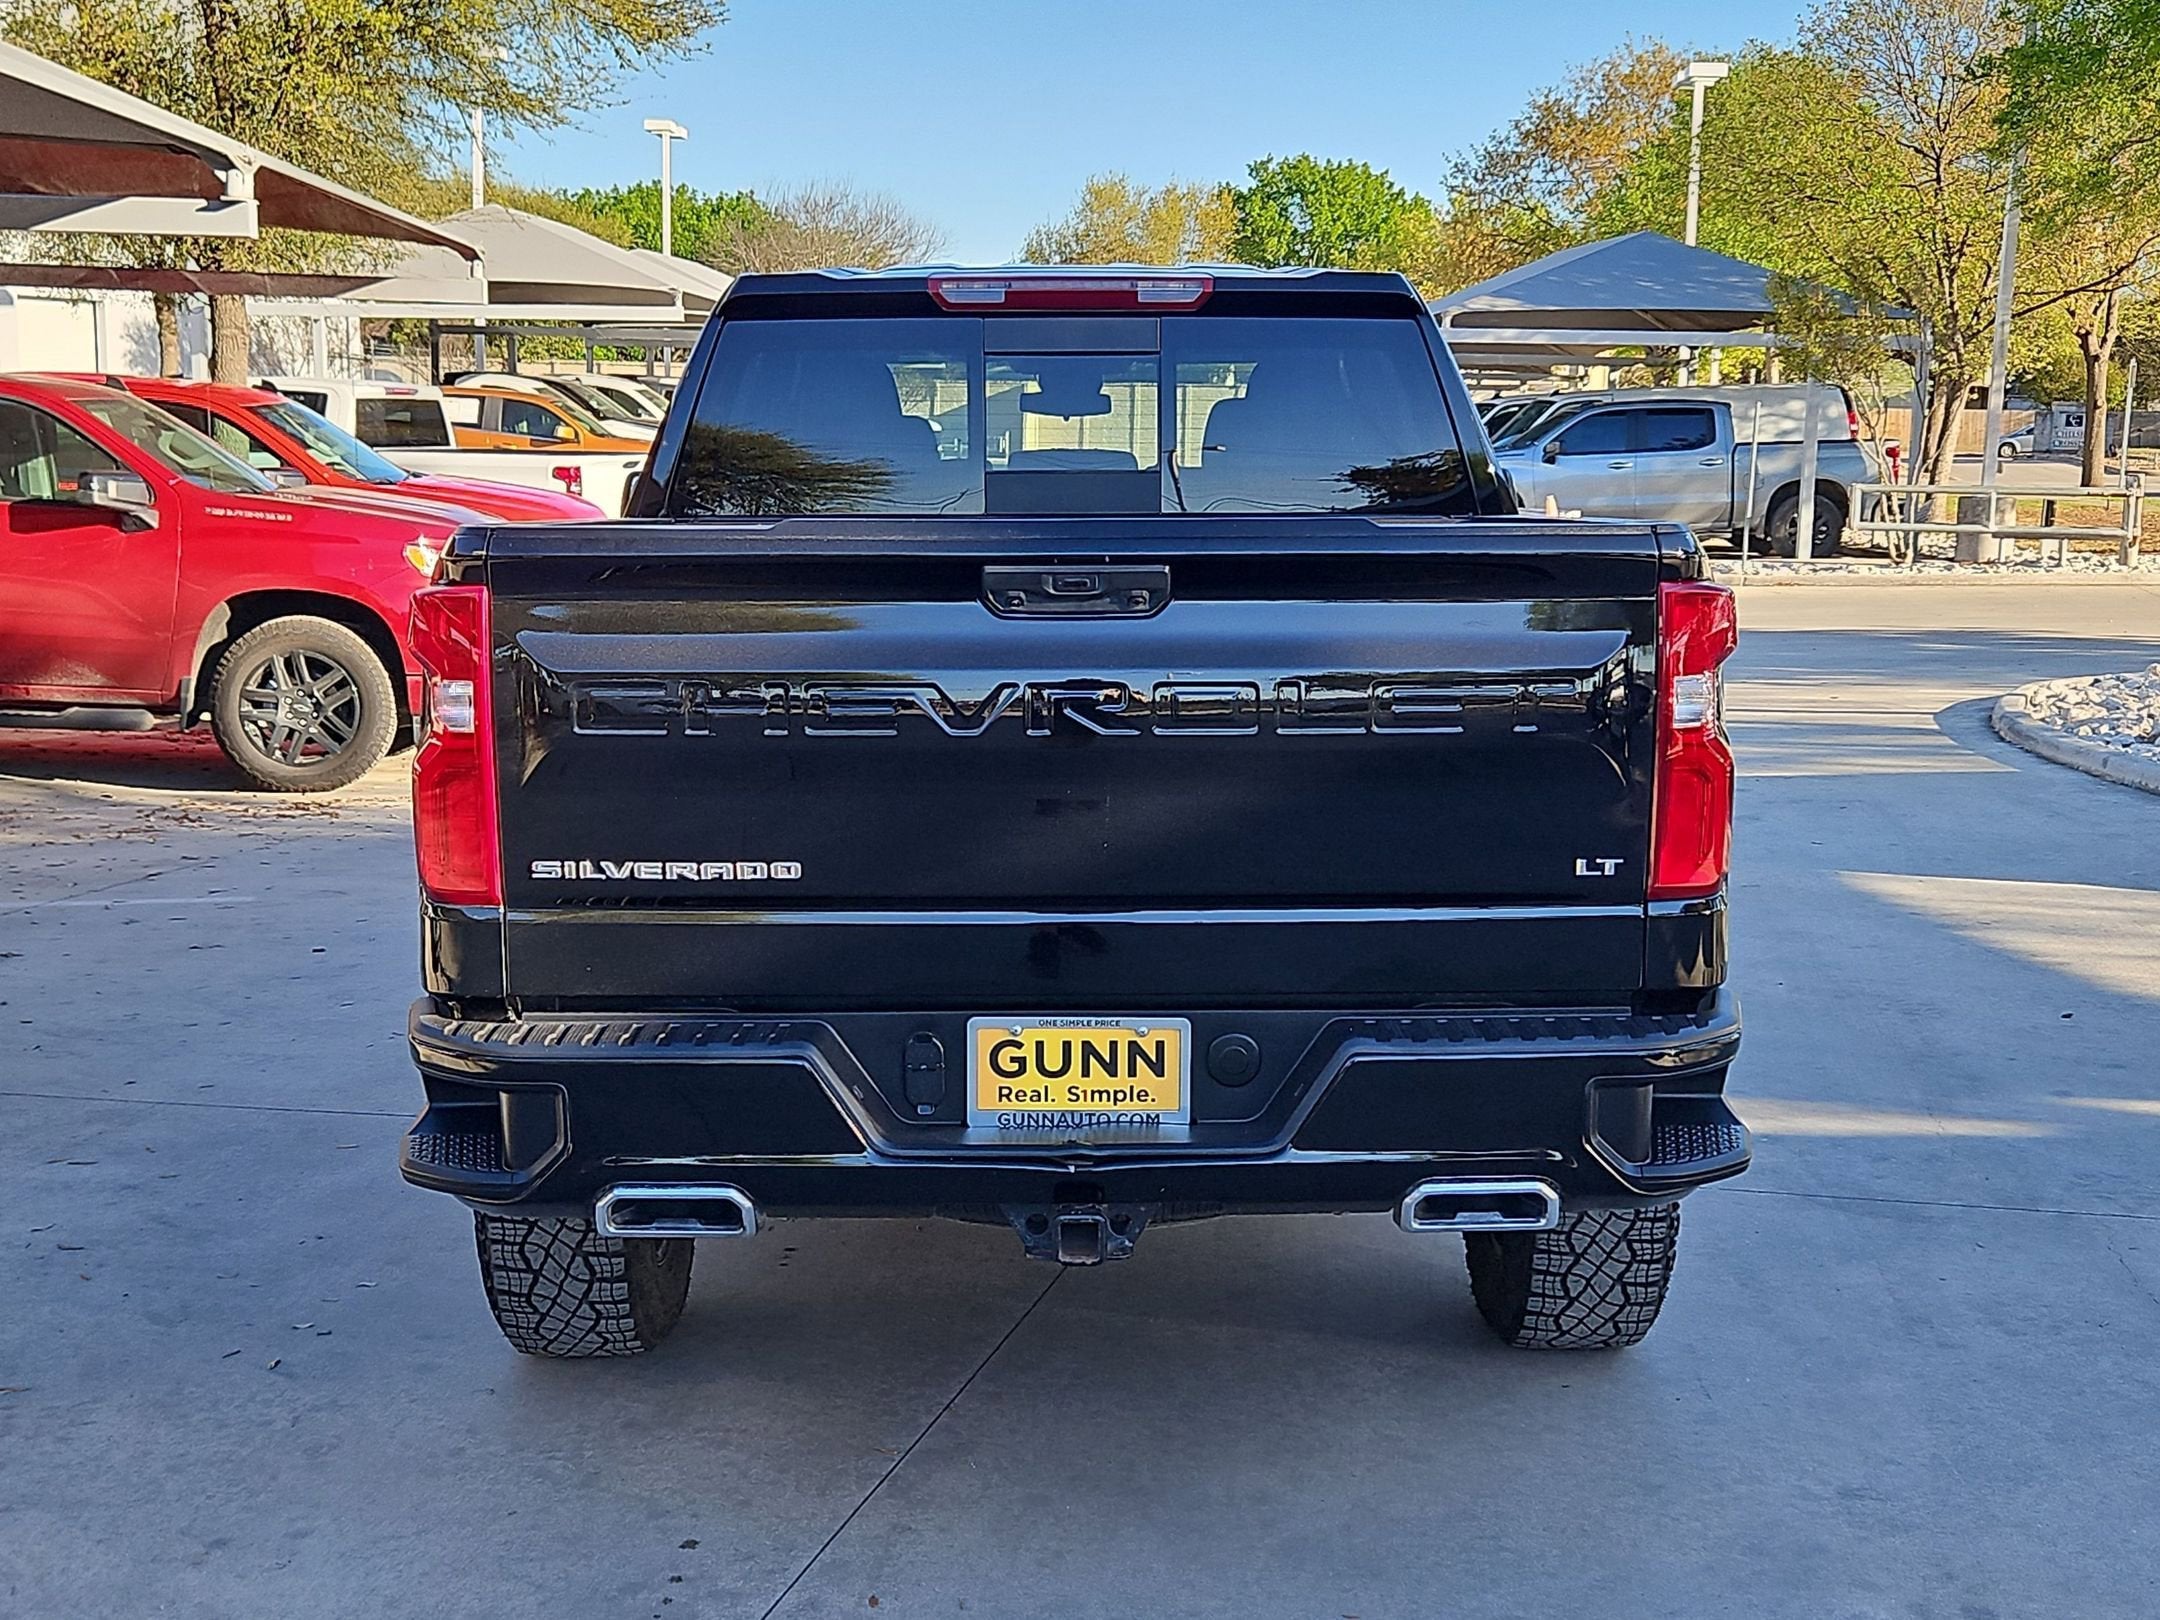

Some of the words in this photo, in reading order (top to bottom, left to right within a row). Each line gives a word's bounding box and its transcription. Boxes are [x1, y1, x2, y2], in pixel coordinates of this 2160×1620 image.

[570, 679, 1579, 737] CHEVROLET
[531, 860, 802, 881] SILVERADO
[1576, 858, 1624, 876] LT
[1038, 1019, 1058, 1028] ONE
[1060, 1019, 1092, 1028] SIMPLE
[1094, 1019, 1121, 1028] PRICE
[988, 1039, 1166, 1079] GUNN
[998, 1085, 1056, 1103] Real.
